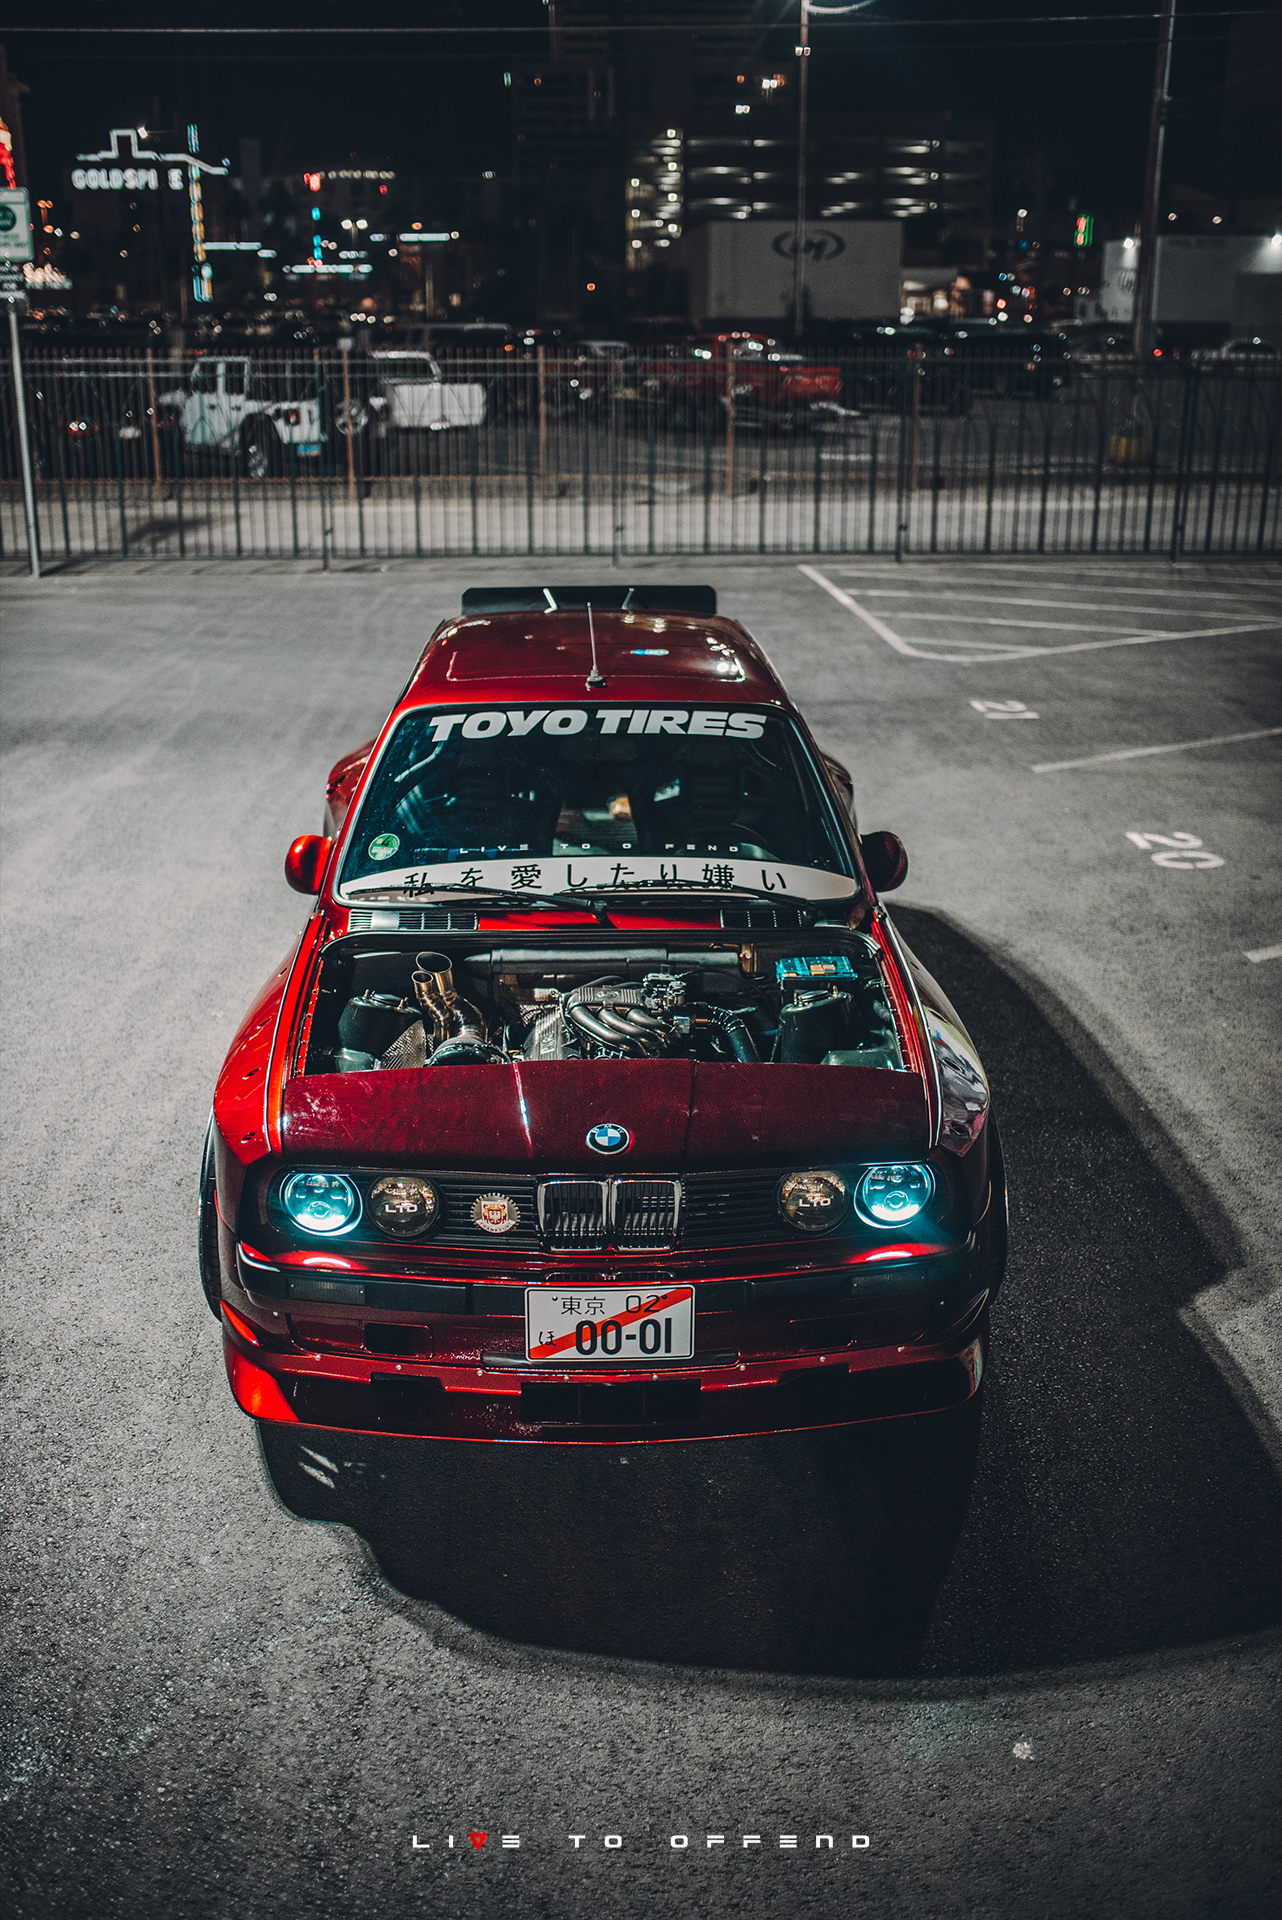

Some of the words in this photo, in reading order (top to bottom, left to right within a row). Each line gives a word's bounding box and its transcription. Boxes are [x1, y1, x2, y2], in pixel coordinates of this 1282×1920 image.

[429, 709, 589, 743] TOYO
[595, 709, 767, 740] TIRES
[380, 835, 391, 848] 4
[459, 843, 529, 854] LIVE
[1124, 831, 1225, 870] 20
[560, 1296, 606, 1316] 東京
[625, 1294, 661, 1314] 02
[538, 1330, 557, 1347] ほ
[575, 1317, 672, 1355] 00-01
